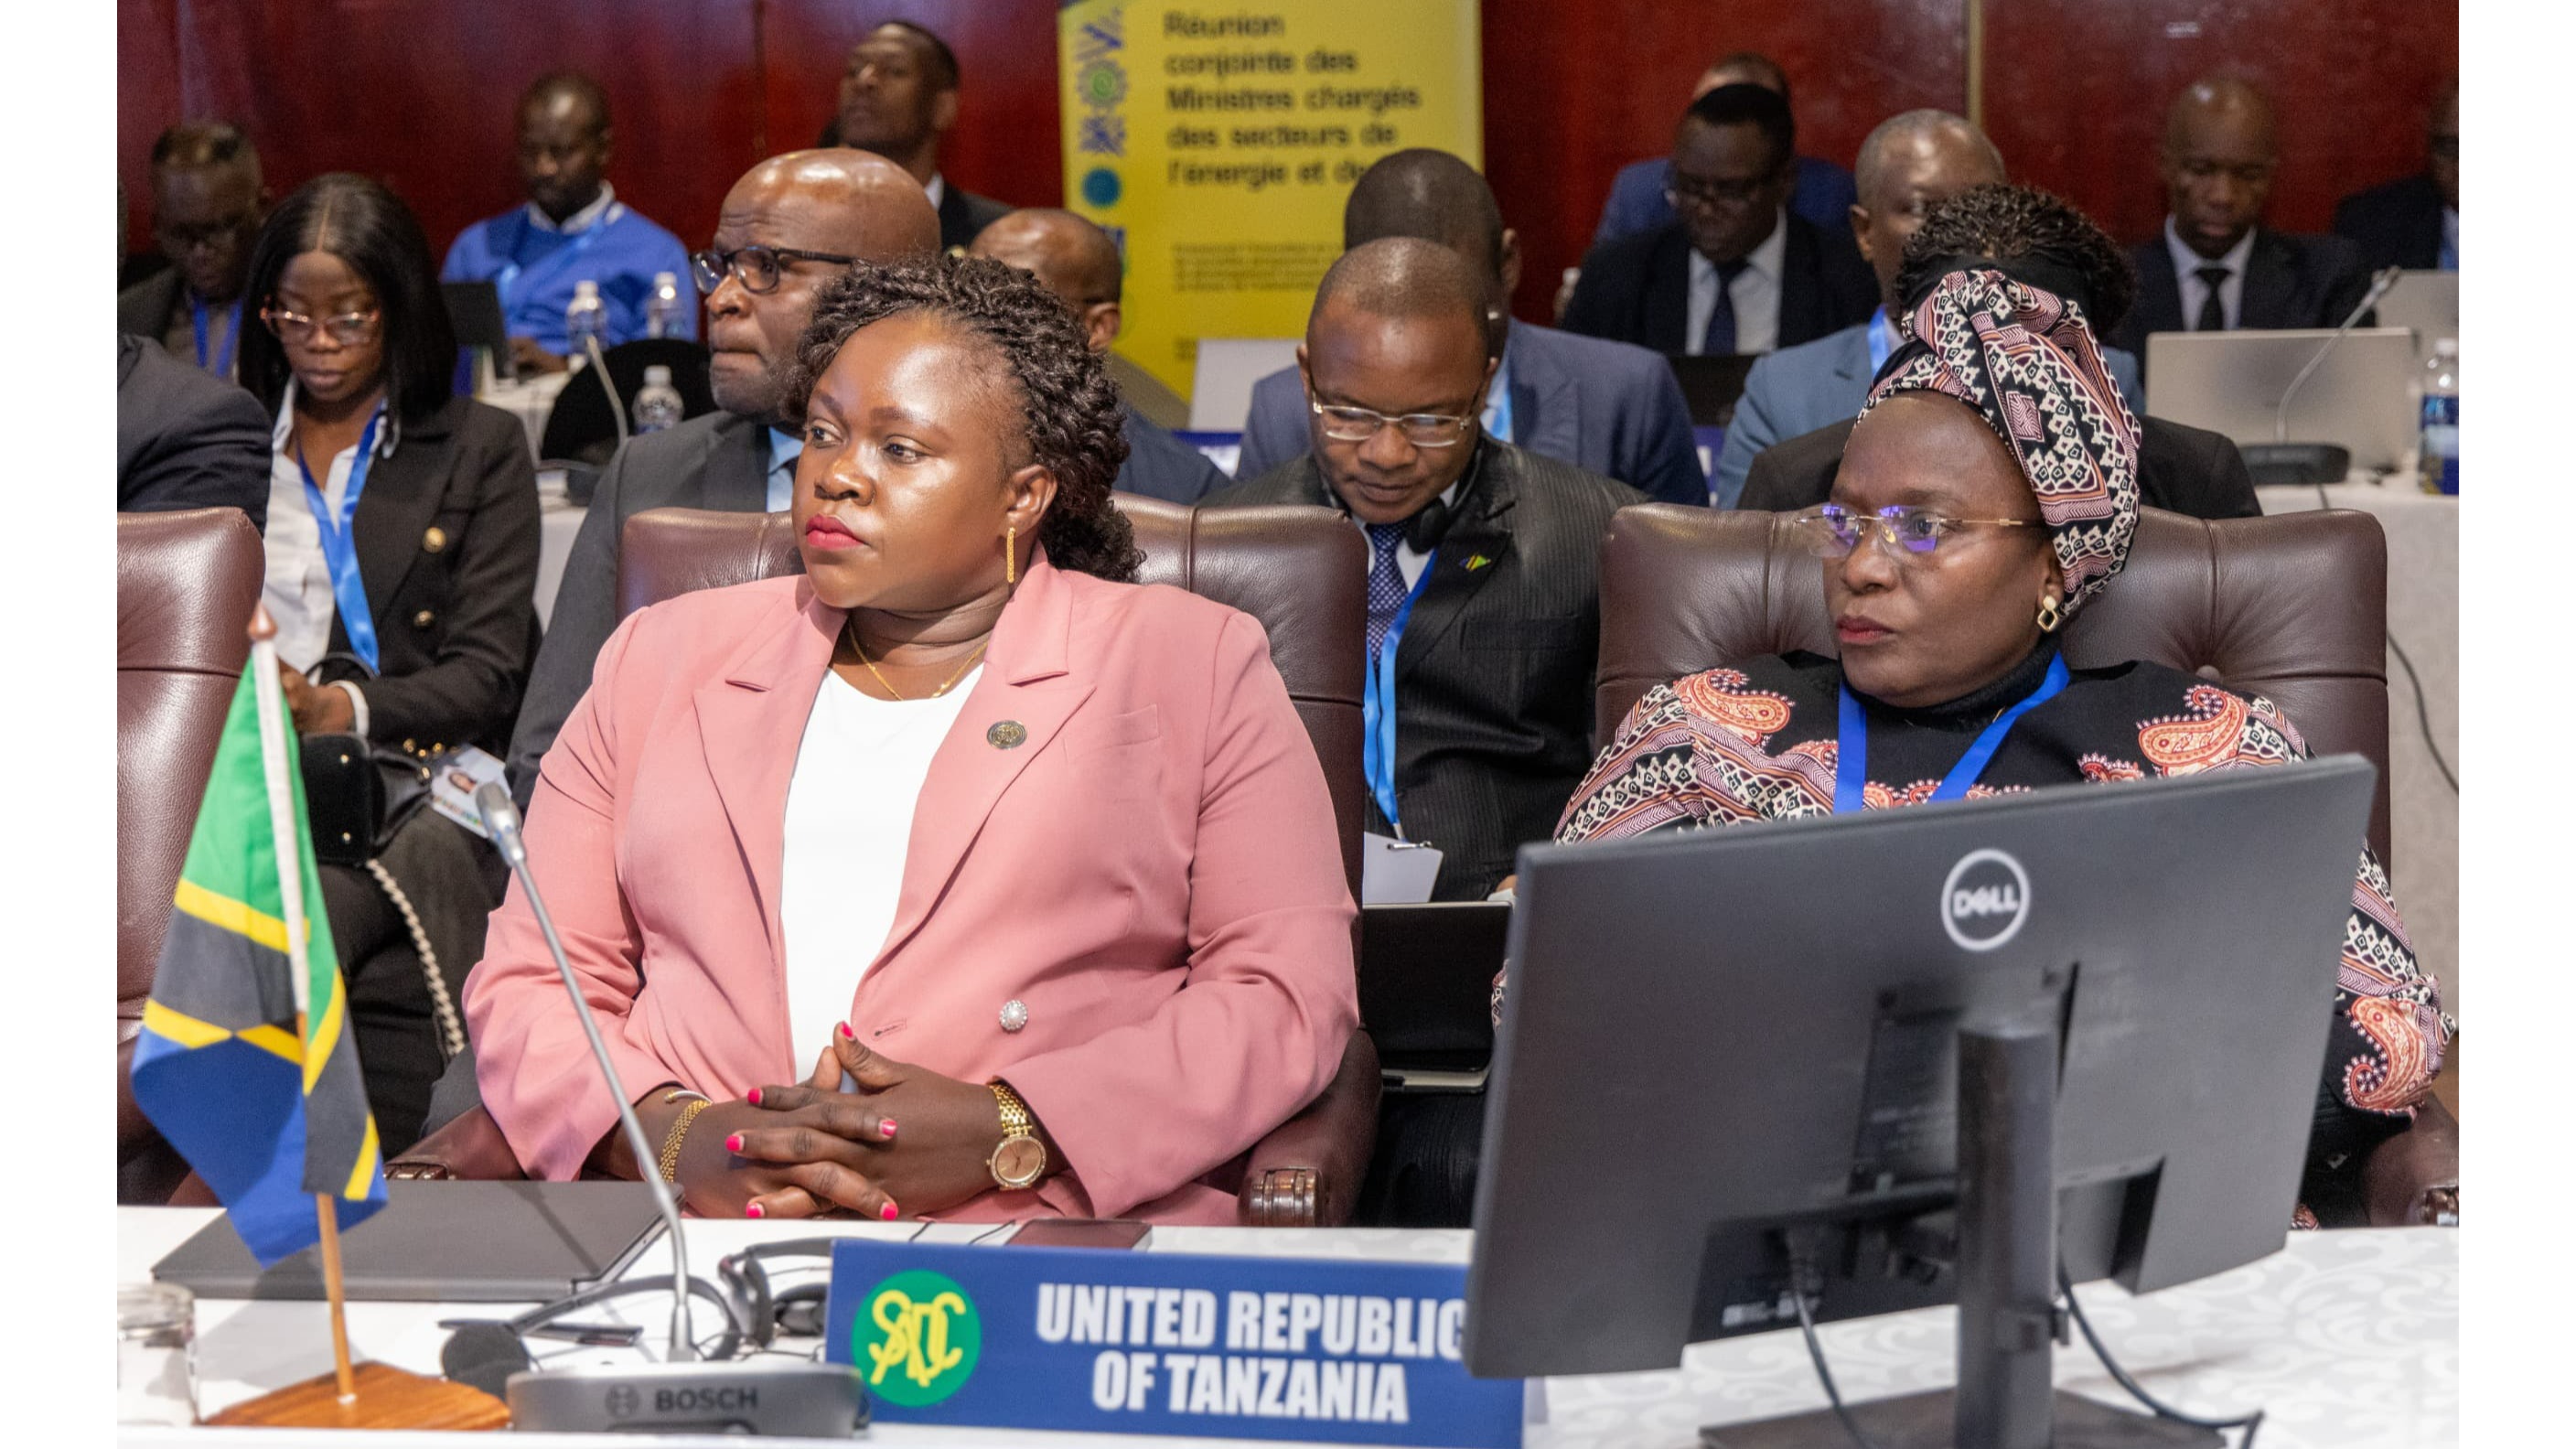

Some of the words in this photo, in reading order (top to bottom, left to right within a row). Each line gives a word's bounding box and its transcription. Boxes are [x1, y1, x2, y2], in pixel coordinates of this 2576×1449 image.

[1164, 10, 1284, 37] Réunion
[1165, 52, 1294, 79] conjointe
[1306, 49, 1356, 73] des
[1167, 87, 1292, 110] Ministres
[1305, 84, 1421, 113] chargés
[1168, 125, 1217, 147] des
[1232, 126, 1348, 146] secteurs
[1360, 123, 1396, 146] de
[1169, 159, 1286, 191] l'énergie
[1299, 161, 1324, 184] et
[1953, 883, 2020, 918] DELL
[1036, 1283, 1218, 1348] UNITED
[1226, 1290, 1466, 1360] REPUBLIC
[655, 1388, 757, 1411] BOSCH
[1092, 1349, 1157, 1411] OF
[1164, 1352, 1410, 1423] TANZANIA
